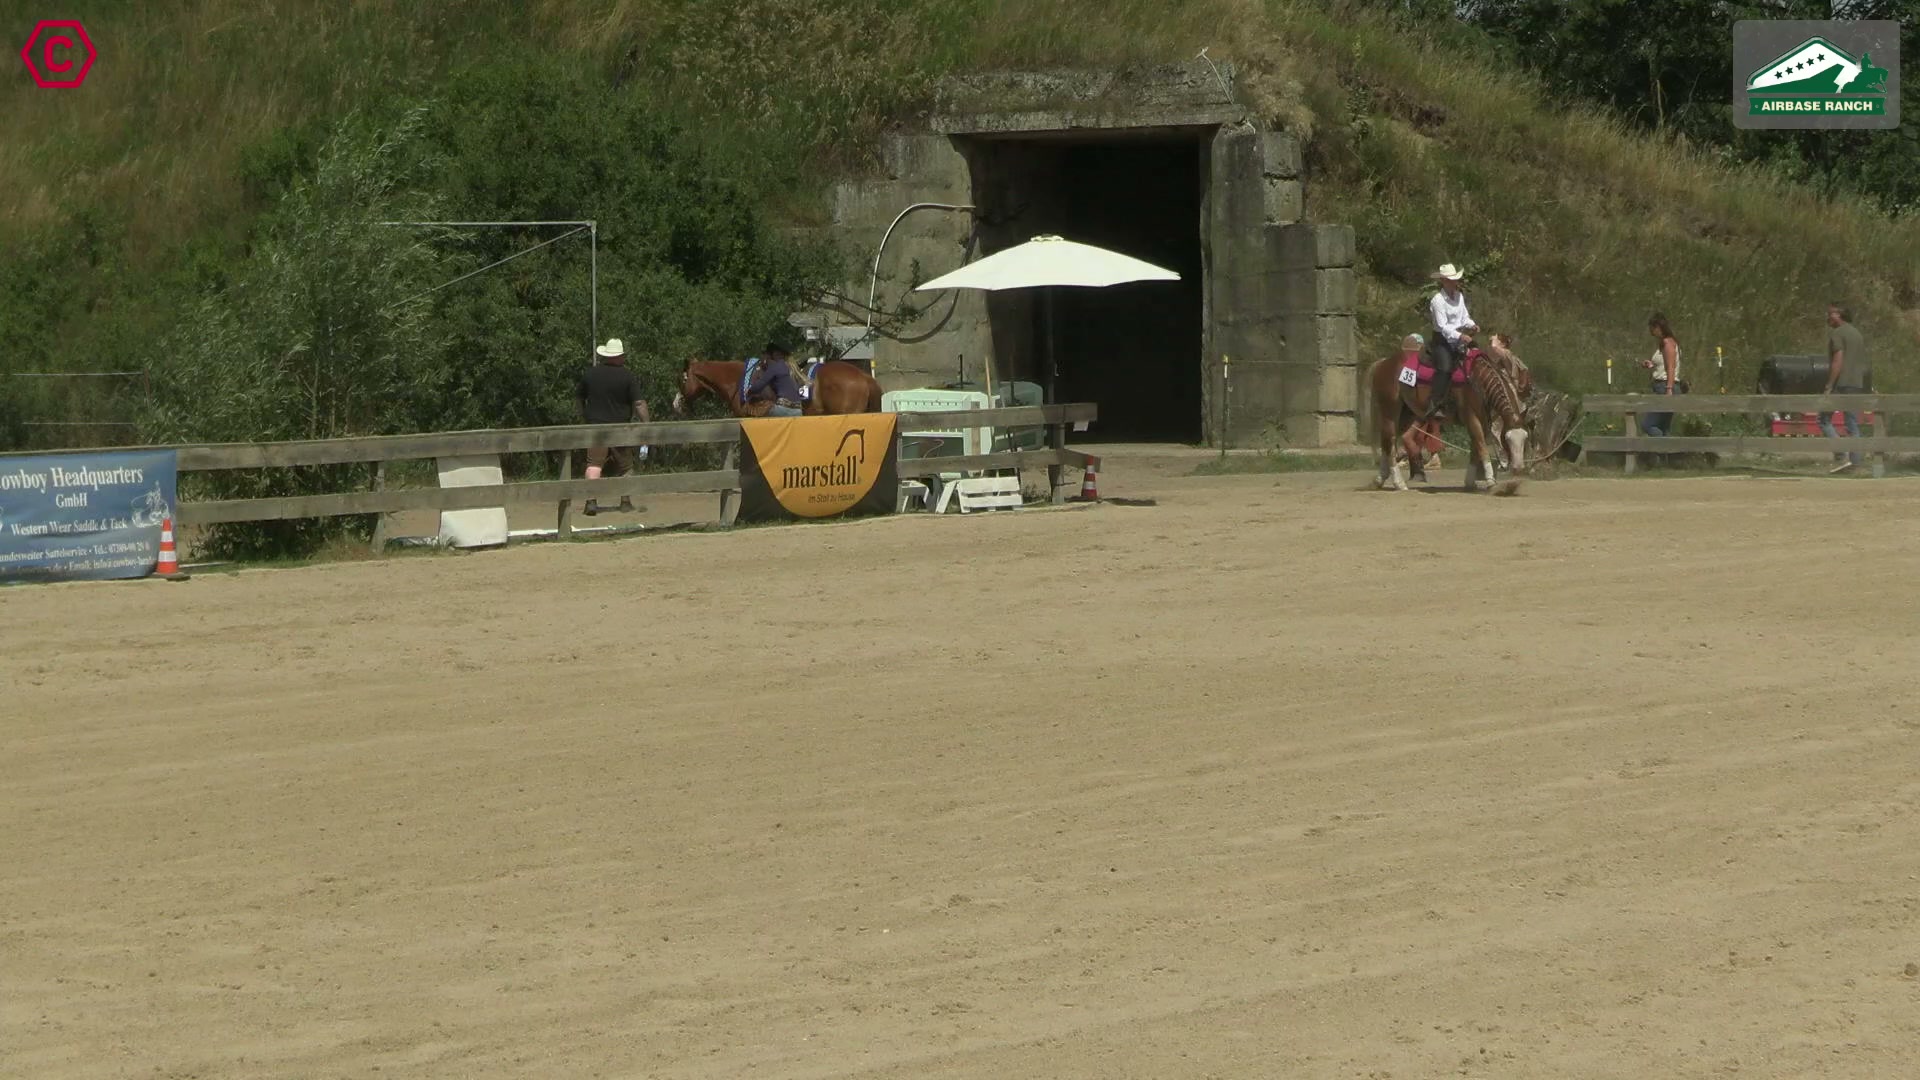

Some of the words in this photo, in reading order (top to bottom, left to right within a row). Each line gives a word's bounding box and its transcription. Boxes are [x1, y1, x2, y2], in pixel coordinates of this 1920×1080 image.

[1403, 371, 1414, 382] 35
[0, 468, 48, 494] owboy
[50, 465, 144, 491] Headquarters
[782, 455, 857, 489] marstall
[55, 492, 88, 509] GmbH
[11, 523, 48, 537] Western
[49, 521, 72, 534] Wear
[73, 519, 99, 532] Saddle
[100, 519, 108, 530] &
